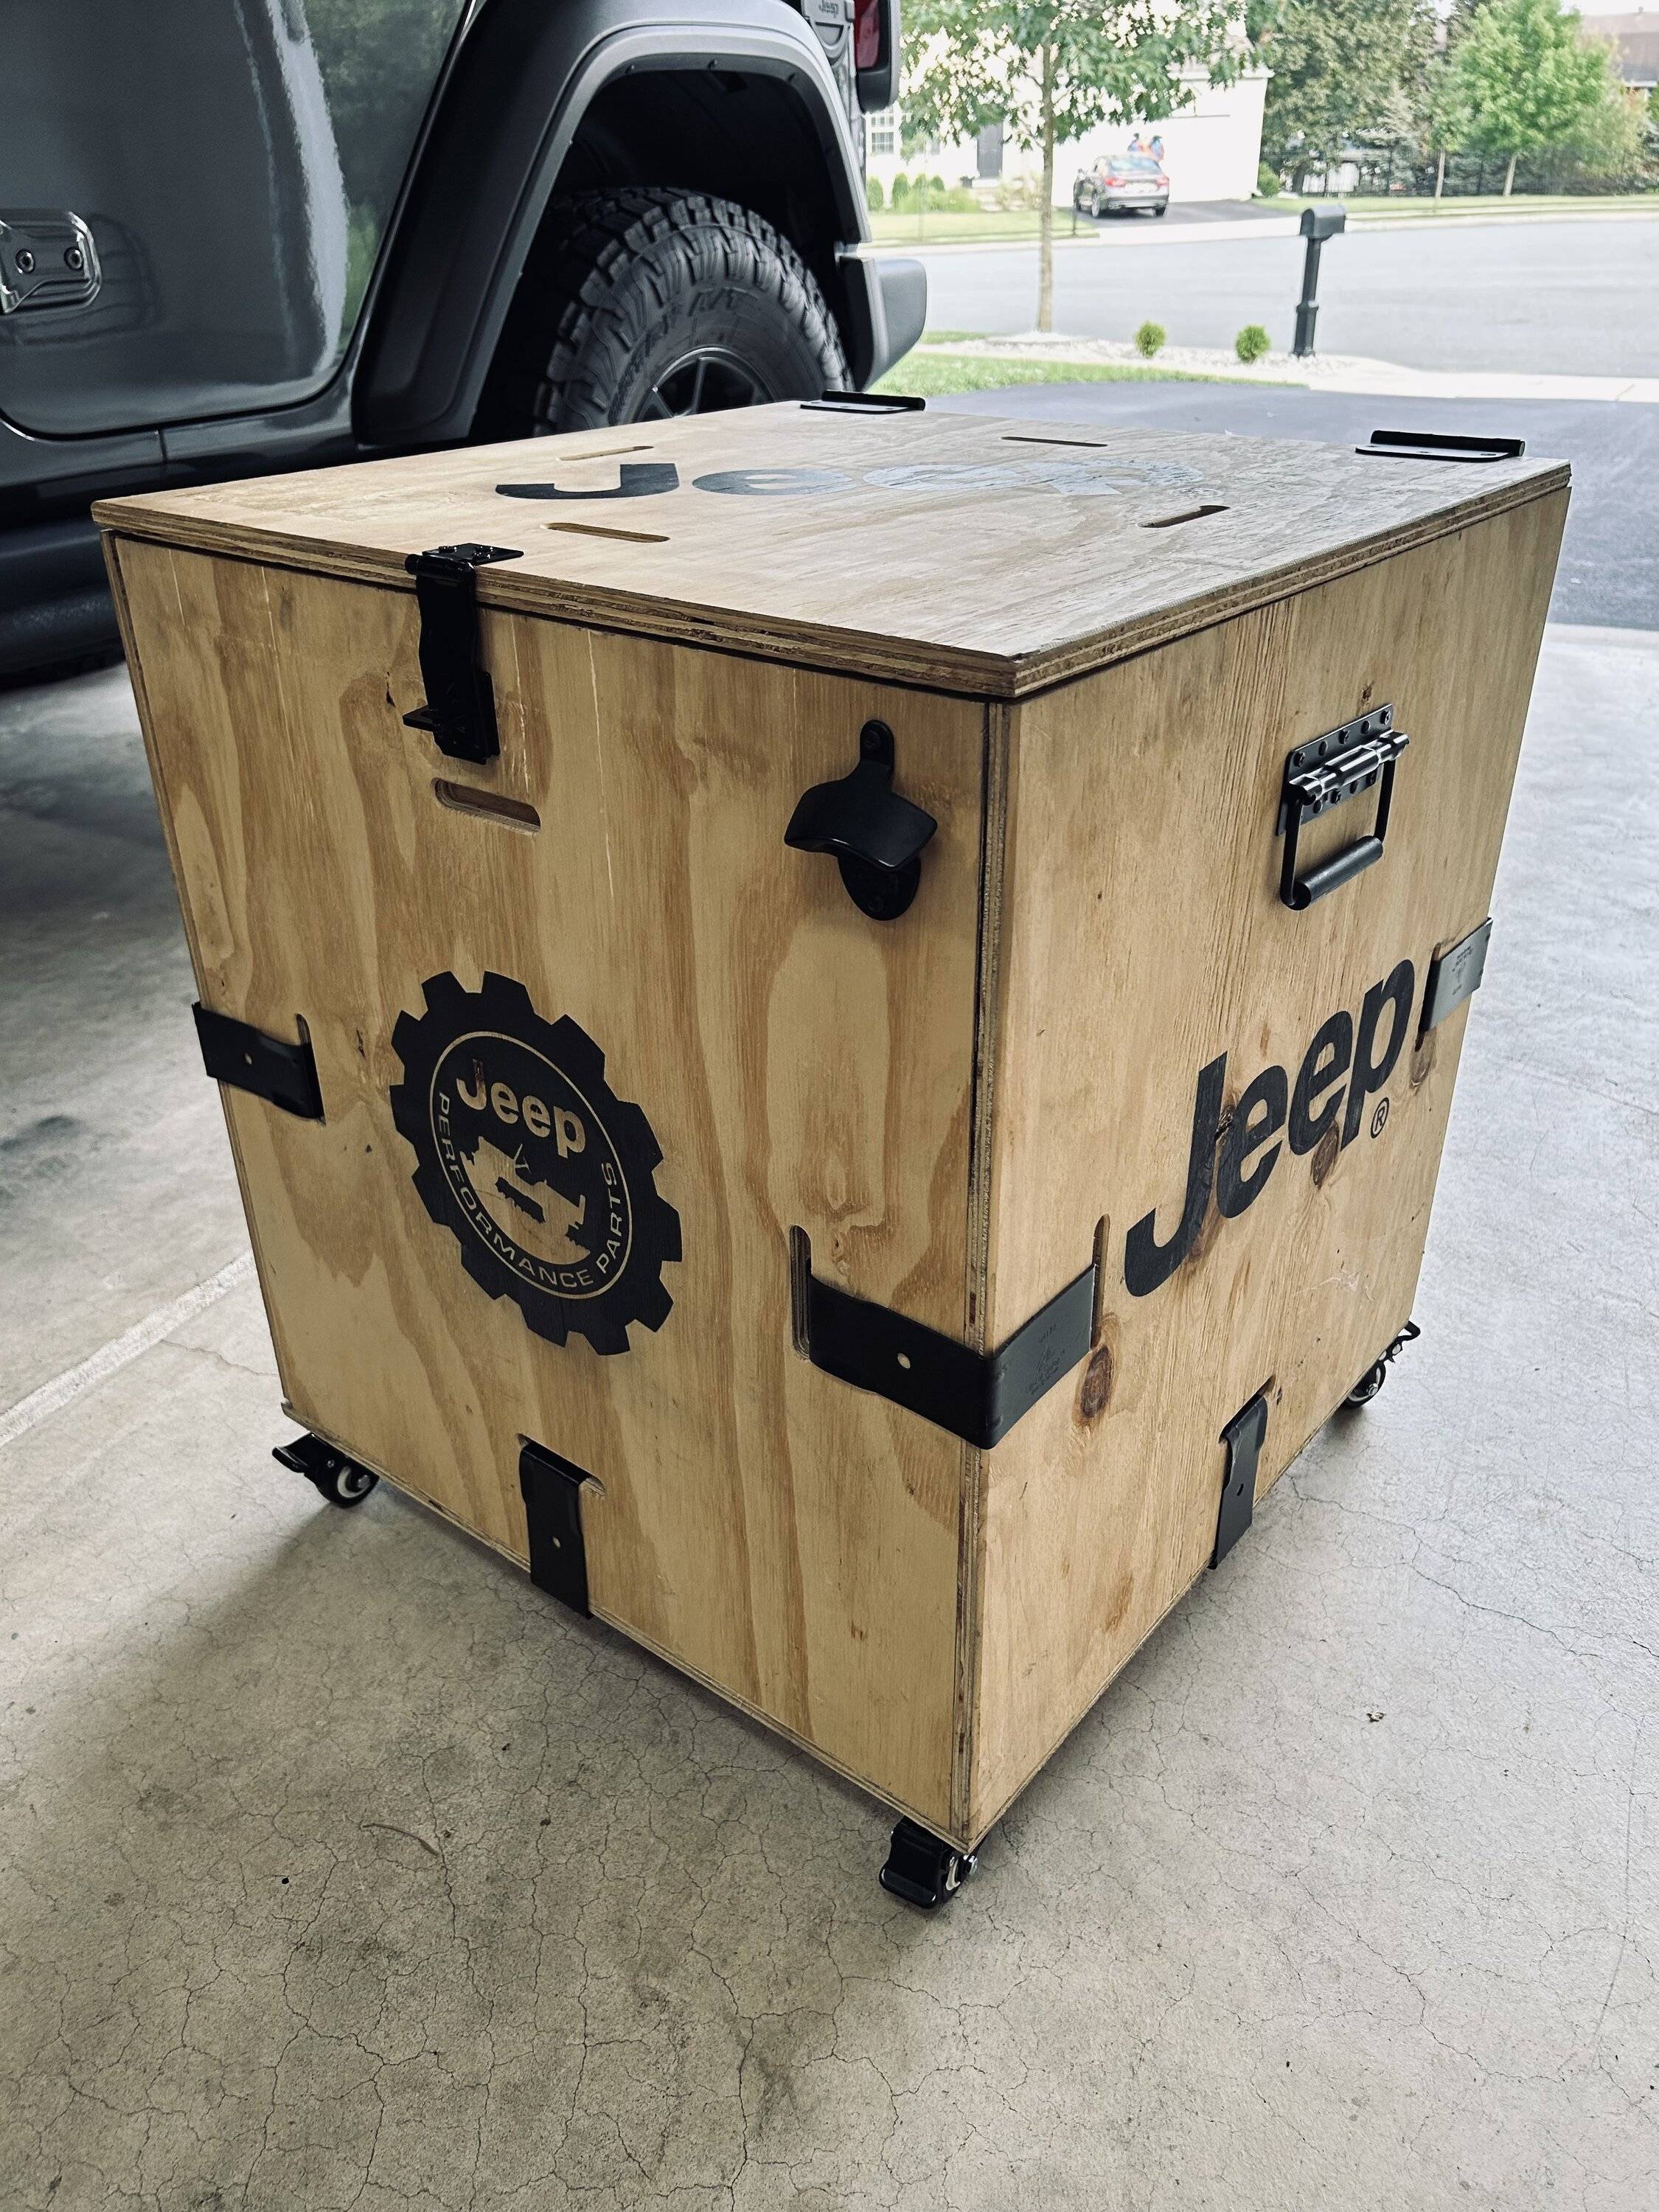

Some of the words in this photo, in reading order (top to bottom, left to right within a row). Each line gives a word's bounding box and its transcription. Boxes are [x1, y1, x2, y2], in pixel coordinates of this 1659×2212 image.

[495, 460, 1206, 500] Jeep
[456, 1059, 586, 1158] Jeep
[1124, 959, 1415, 1298] Jeep
[437, 1092, 594, 1289] PERFORMANCE
[596, 1162, 624, 1275] PARTS
